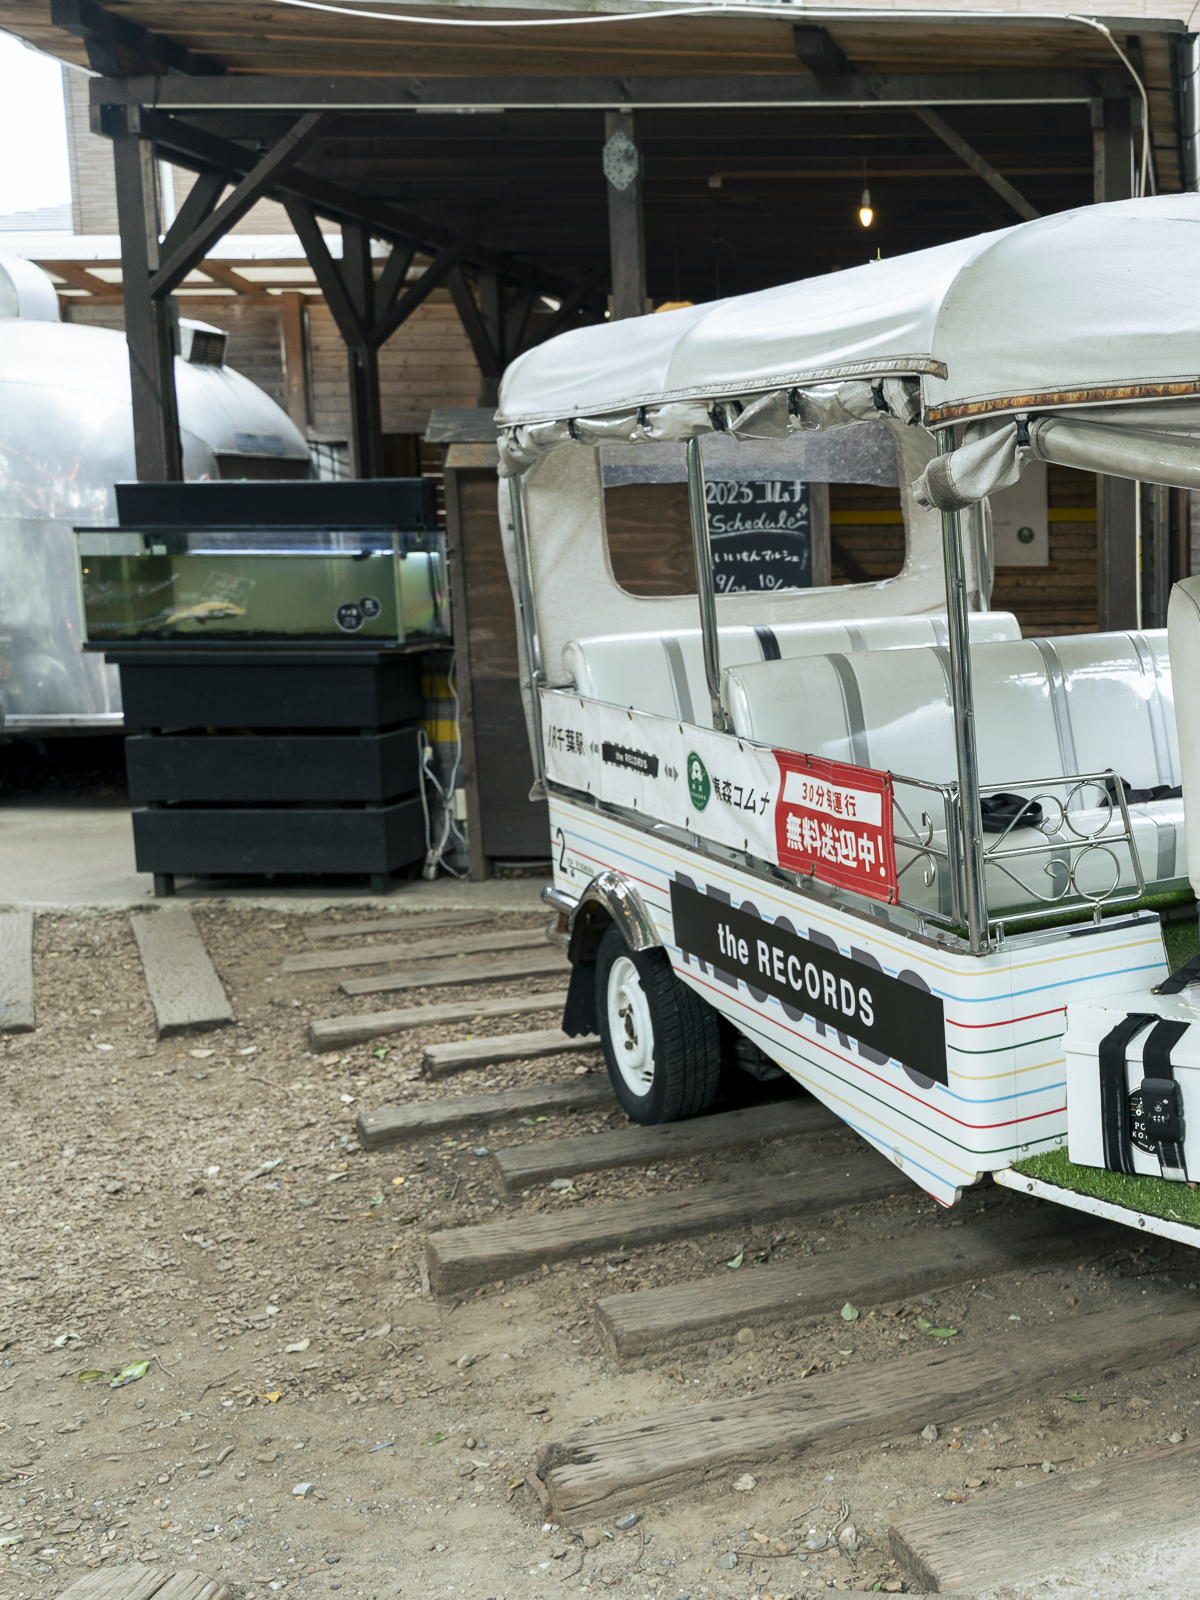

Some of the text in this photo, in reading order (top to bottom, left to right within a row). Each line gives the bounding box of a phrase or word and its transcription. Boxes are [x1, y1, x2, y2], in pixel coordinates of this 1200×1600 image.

[711, 509, 808, 533] Schedule
[717, 922, 875, 1028] the RECORDS
